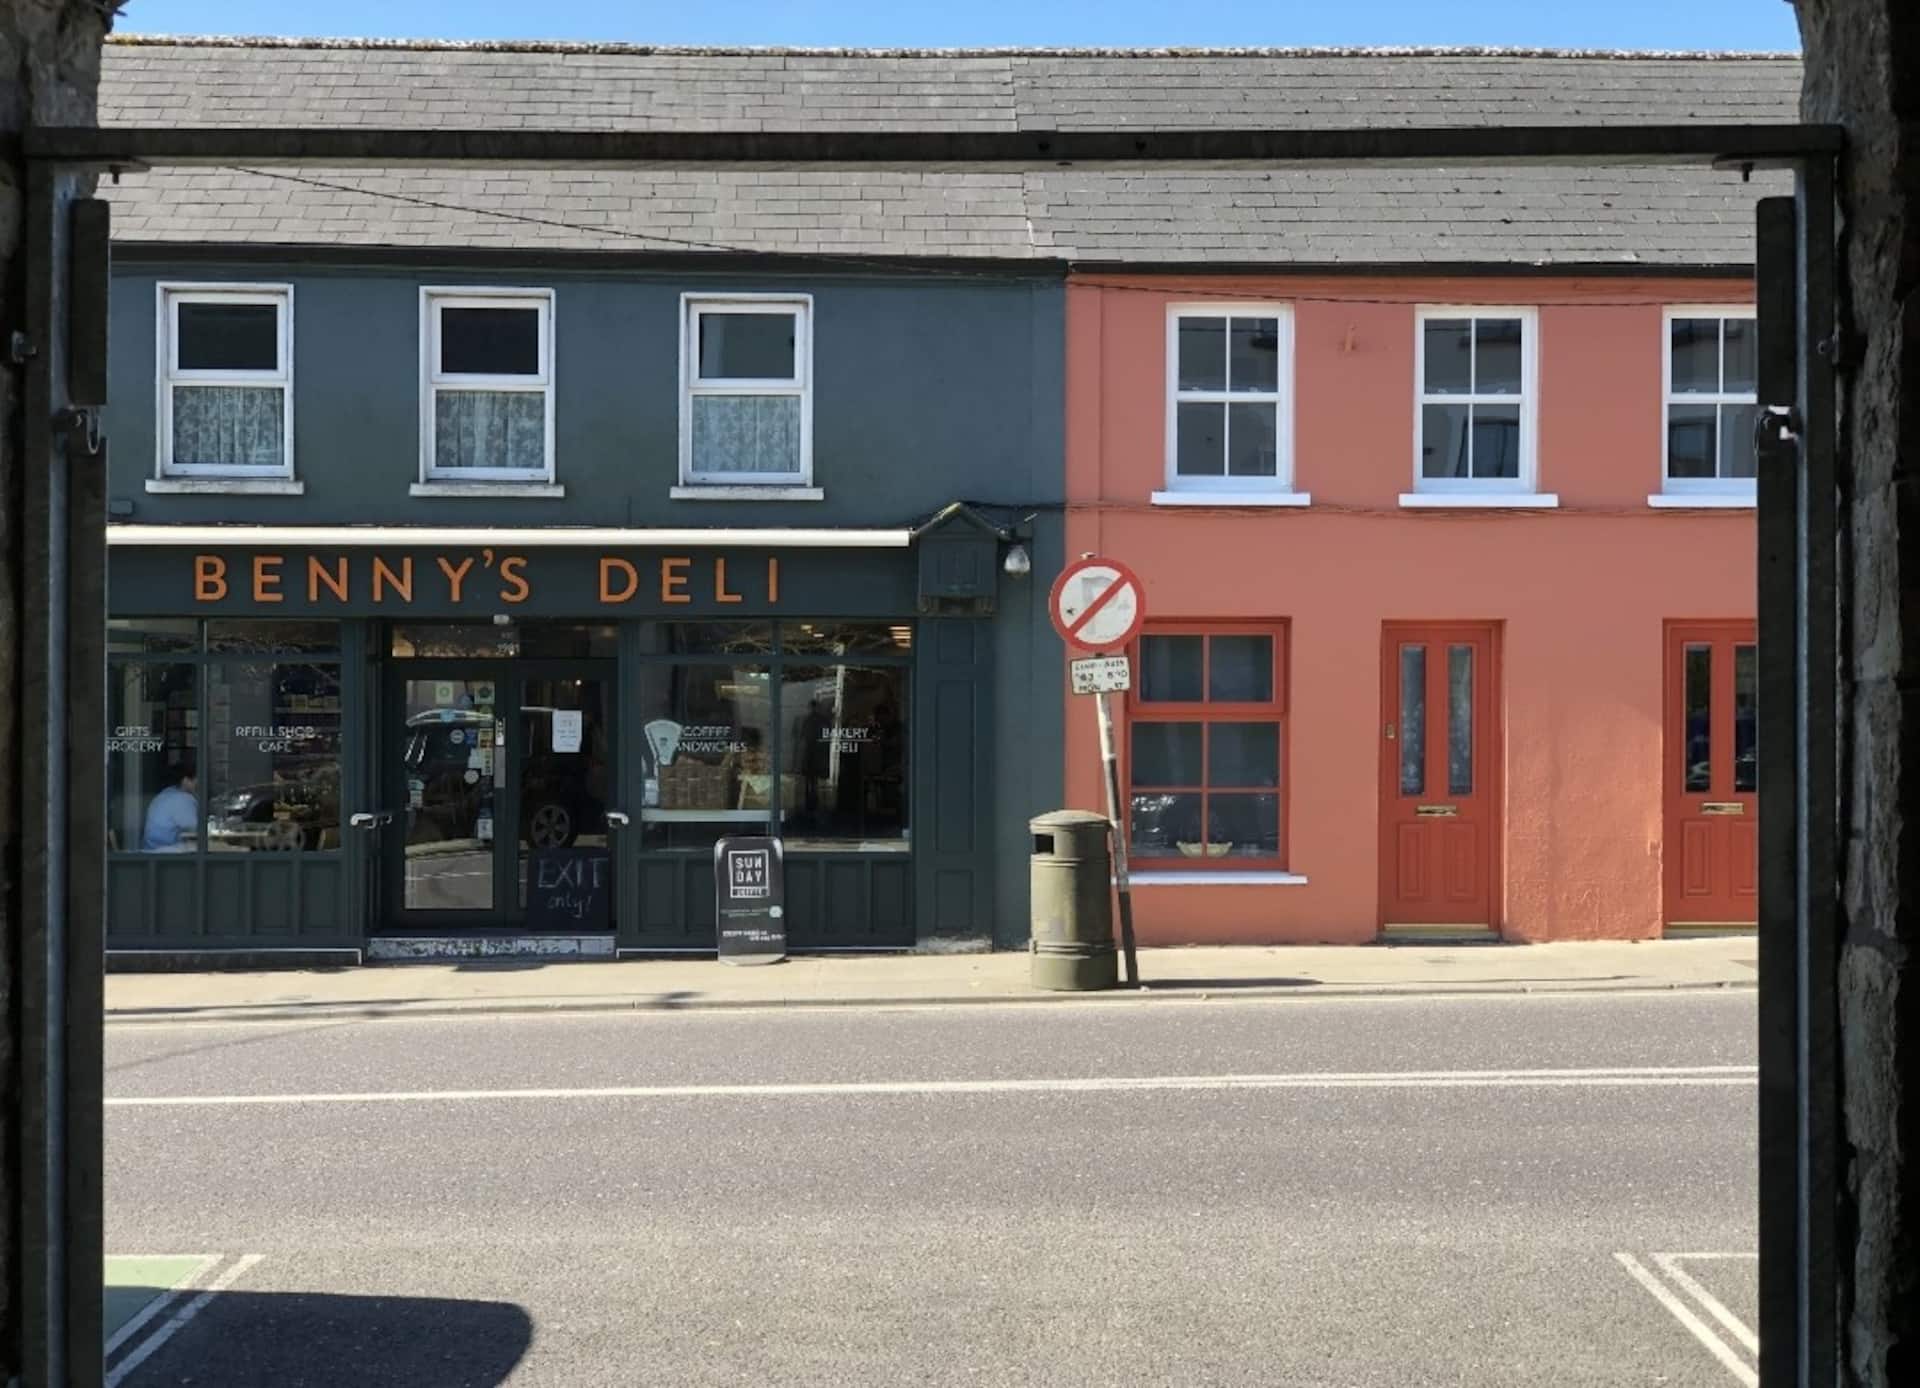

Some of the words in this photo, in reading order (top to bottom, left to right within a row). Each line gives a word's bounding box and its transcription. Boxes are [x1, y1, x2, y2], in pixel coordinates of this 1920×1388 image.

[194, 550, 530, 603] BENNY'S
[598, 557, 779, 603] DELI
[115, 726, 151, 737] GIFTS
[822, 727, 869, 738] BAKERY
[833, 742, 858, 753] DELI
[735, 856, 763, 869] SUN
[537, 857, 609, 888] EXIT
[736, 869, 763, 883] DAY
